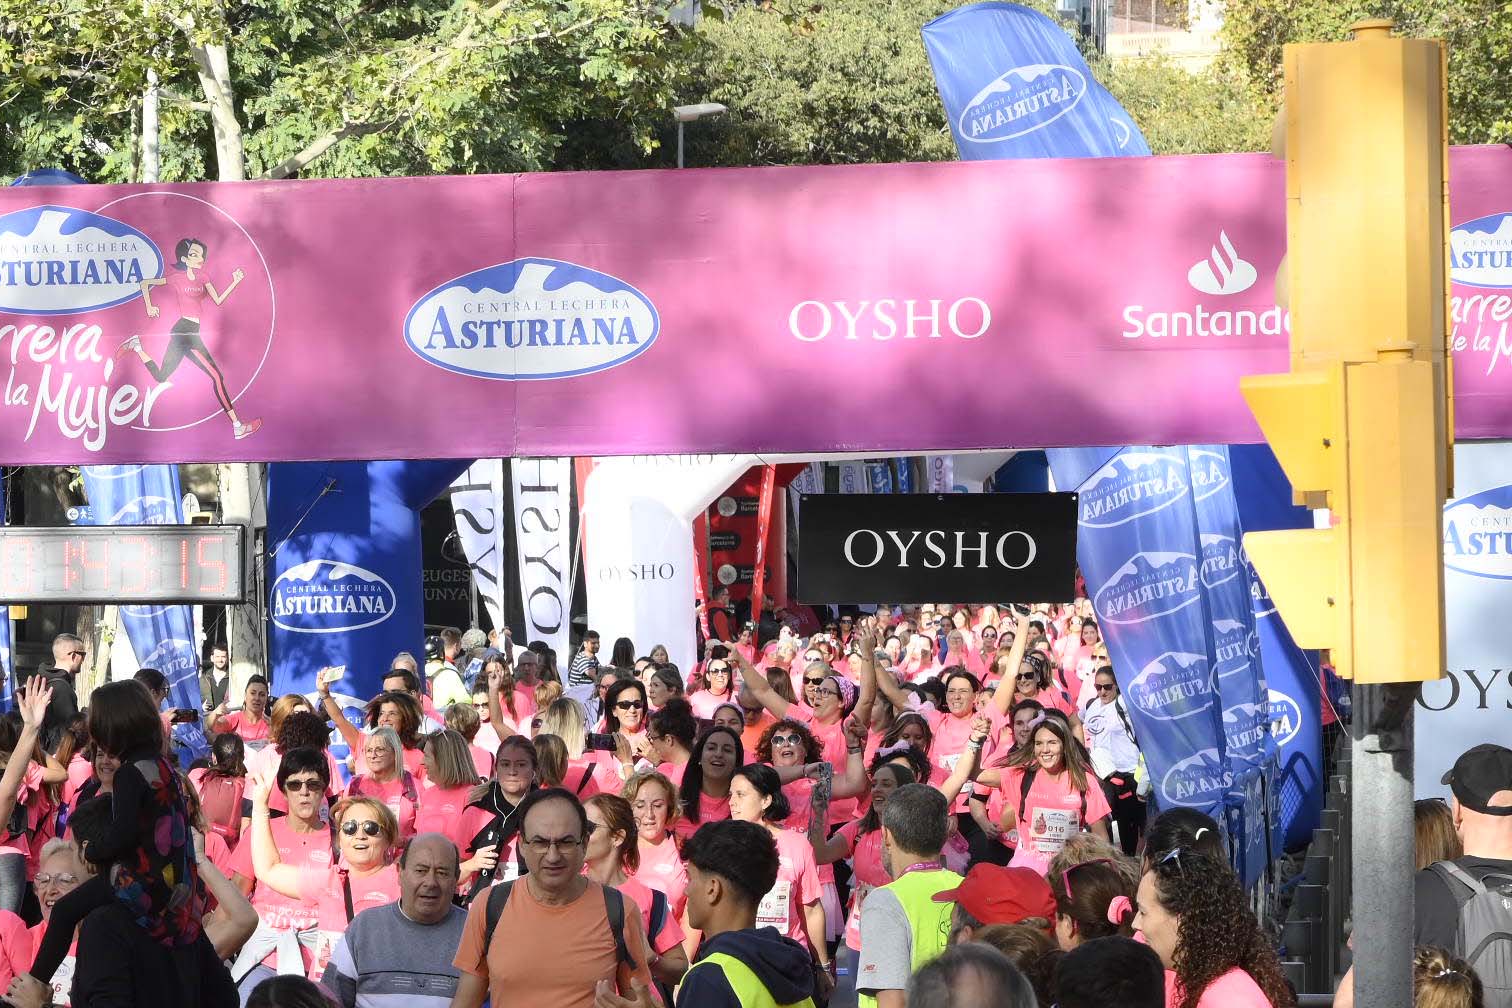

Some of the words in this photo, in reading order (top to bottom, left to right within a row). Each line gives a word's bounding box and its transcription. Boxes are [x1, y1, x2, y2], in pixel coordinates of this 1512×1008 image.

[65, 241, 139, 254] LECHERA
[463, 299, 543, 313] CENTRAL
[550, 298, 630, 312] LECHERA
[788, 297, 992, 342] OYSHO
[424, 305, 639, 349] ASTURIANA
[1122, 304, 1293, 337] Santand
[5, 366, 29, 406] la
[25, 360, 174, 452] Mujer
[844, 528, 1037, 571] OYSHO
[599, 562, 675, 581] OYSHO
[274, 588, 387, 617] ASTURIANA
[286, 585, 329, 594] CENTRAL
[333, 584, 382, 593] LECHERA
[1048, 825, 1064, 833] 016
